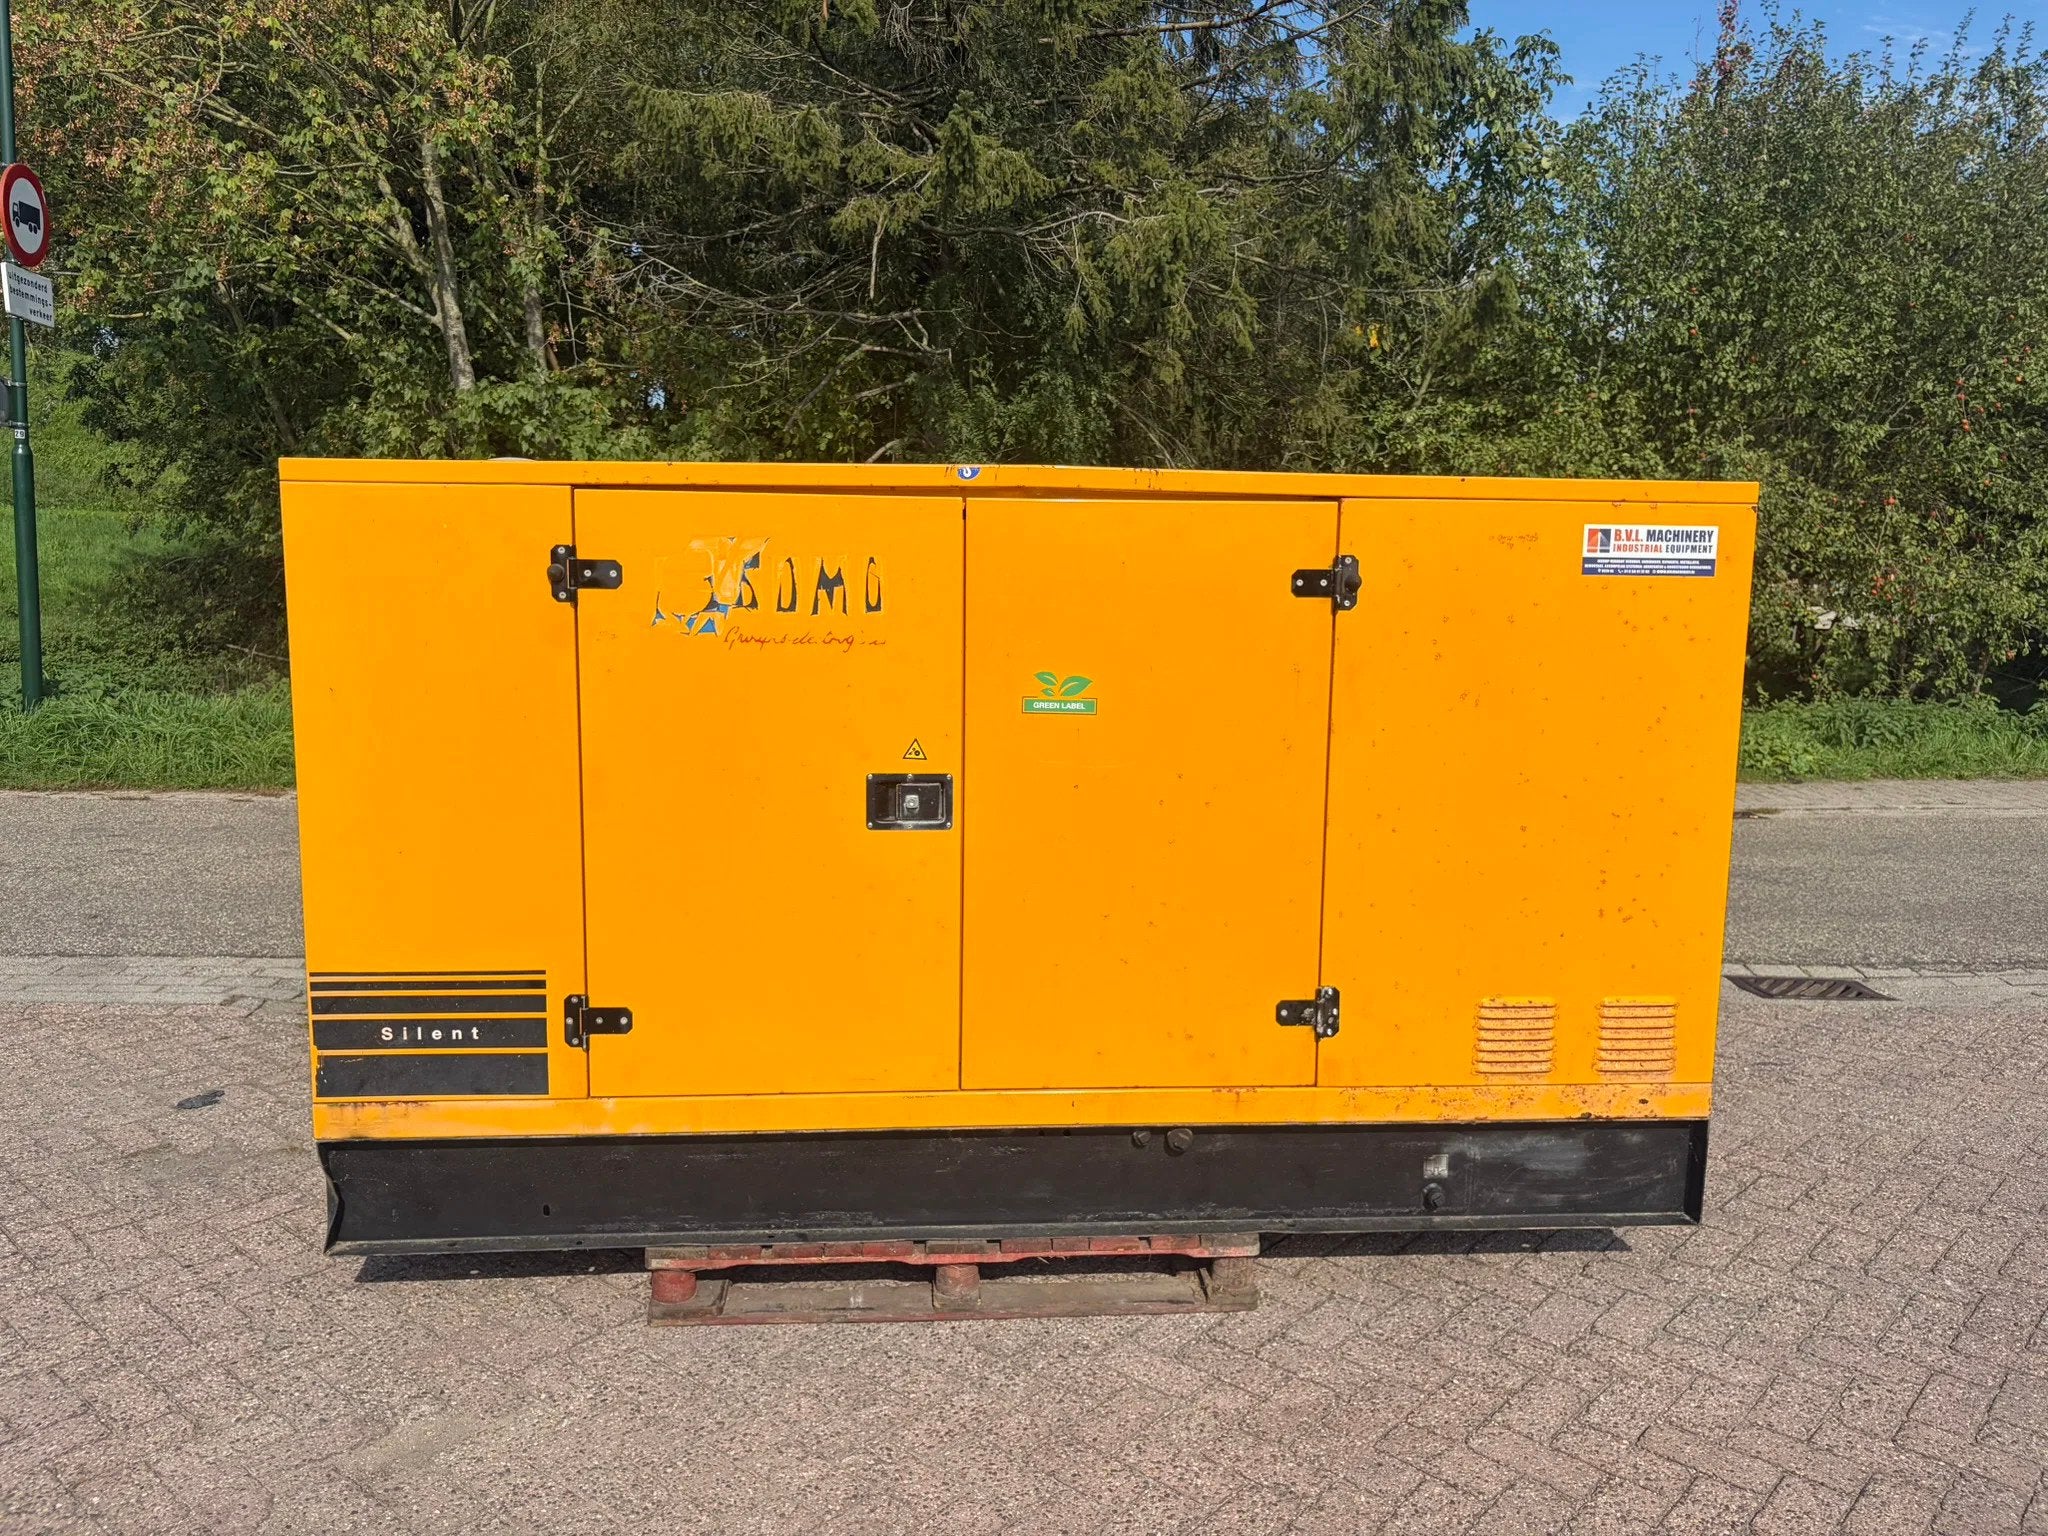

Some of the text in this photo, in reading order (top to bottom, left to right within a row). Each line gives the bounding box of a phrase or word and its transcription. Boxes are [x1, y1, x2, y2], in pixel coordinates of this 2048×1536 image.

[8, 270, 48, 293] uitgezonderd
[9, 284, 52, 308] bestemmings-
[29, 308, 52, 321] verkeer
[1614, 528, 1714, 543] B.V.L. MACHINERY
[1612, 543, 1713, 554] INDUSTRIAL EQUIPMENT
[1033, 701, 1086, 710] GREEN LABEL
[381, 1026, 480, 1041] Silent
